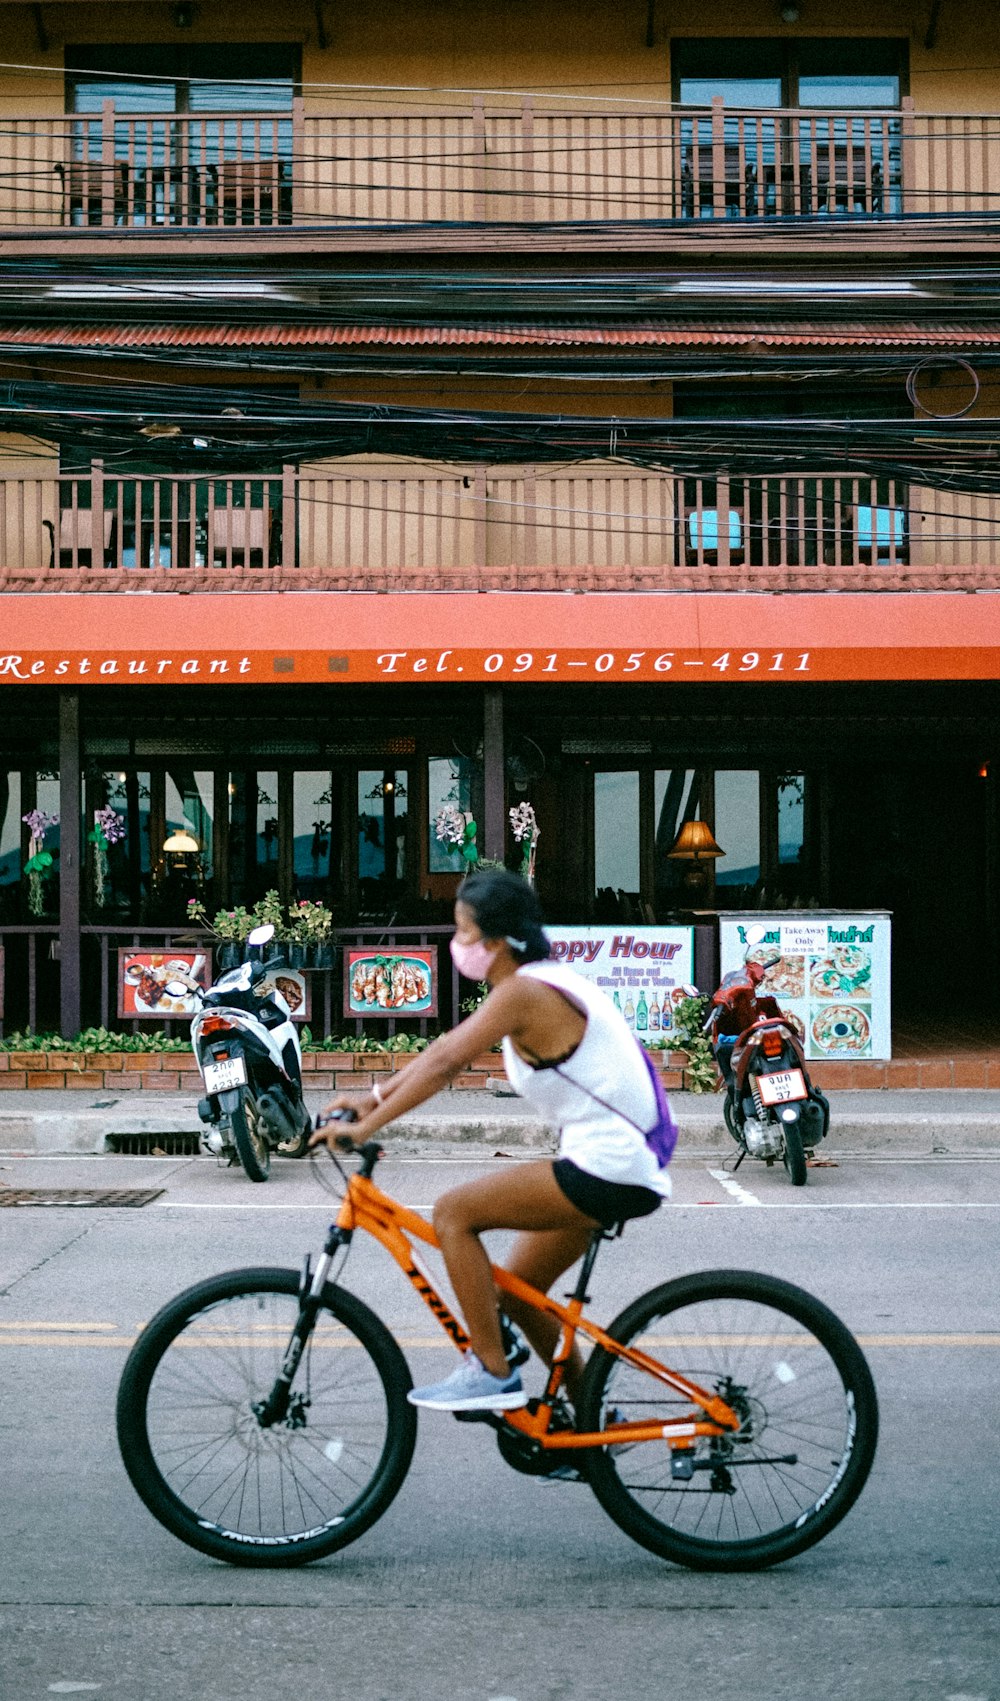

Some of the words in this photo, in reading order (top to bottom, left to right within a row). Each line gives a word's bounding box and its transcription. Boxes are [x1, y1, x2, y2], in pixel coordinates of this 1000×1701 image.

[0, 655, 252, 678] Restaurant
[377, 651, 464, 673] Tel.
[484, 652, 811, 672] 091-056-4911
[784, 927, 803, 935] Take
[805, 927, 826, 937] Away
[794, 936, 814, 946] Only
[549, 939, 604, 962] ppy
[609, 935, 683, 960] Hour
[646, 966, 661, 976] and
[212, 1077, 240, 1091] 4232
[777, 1090, 791, 1100] 37
